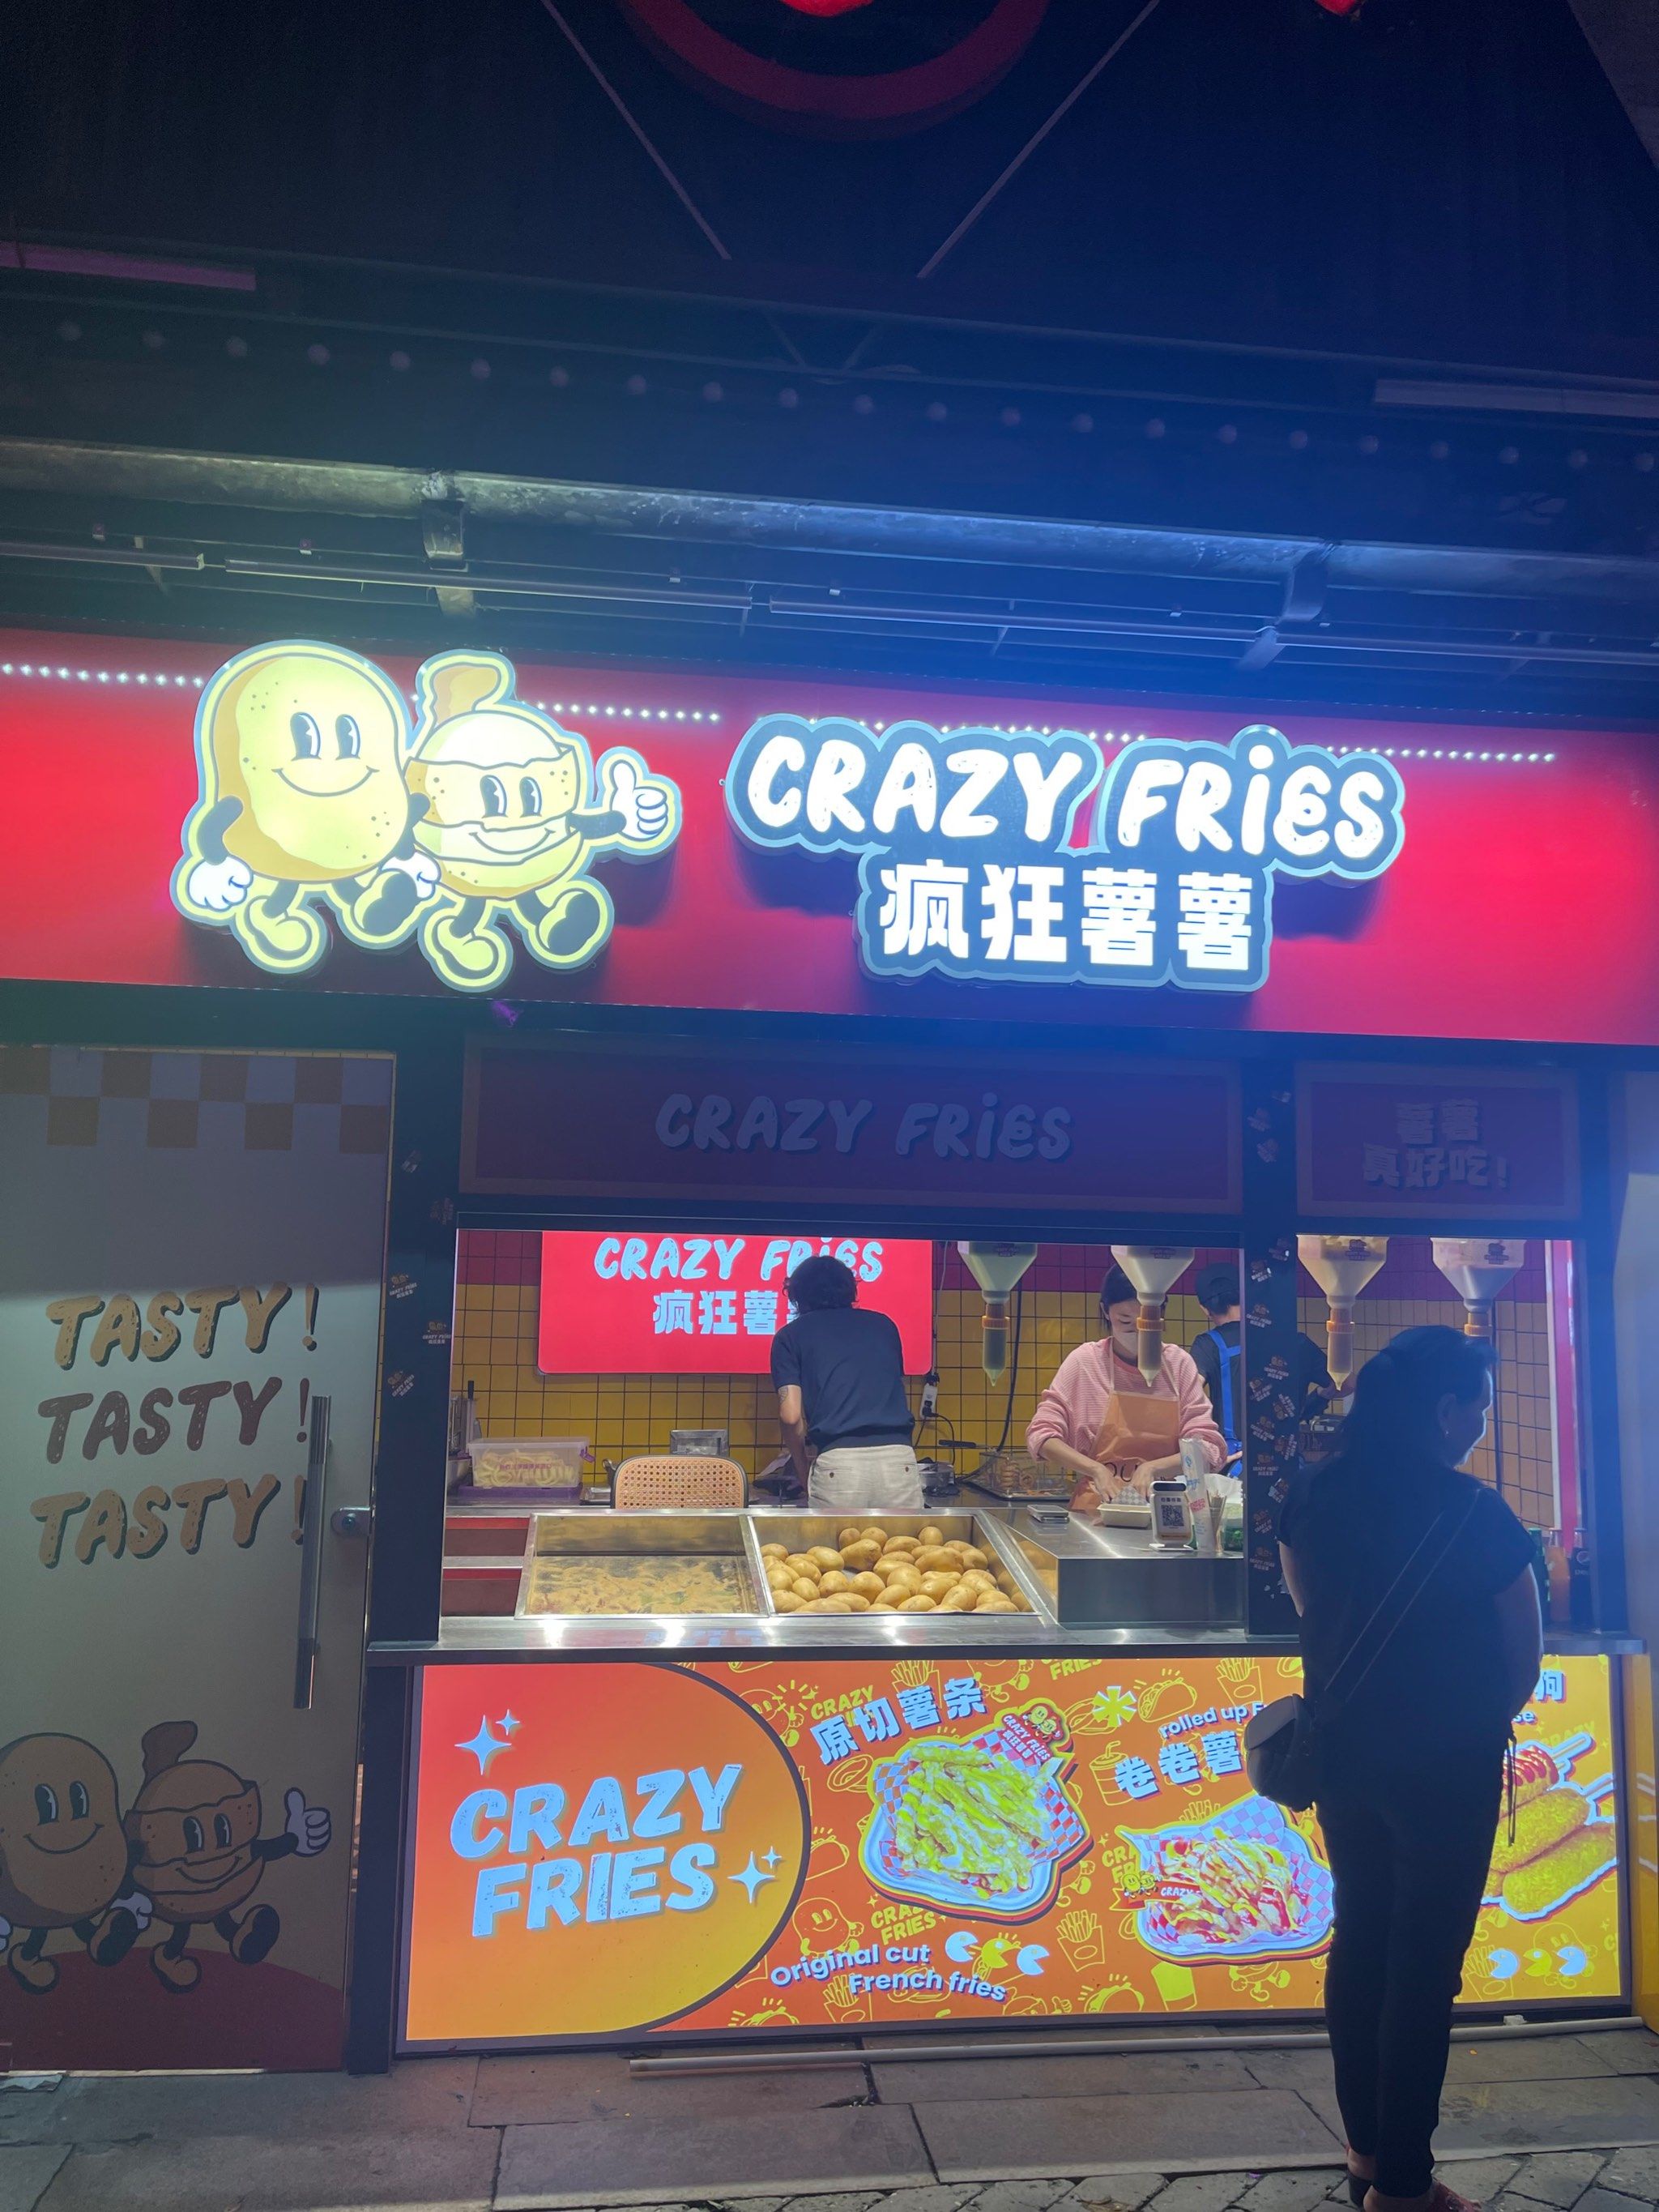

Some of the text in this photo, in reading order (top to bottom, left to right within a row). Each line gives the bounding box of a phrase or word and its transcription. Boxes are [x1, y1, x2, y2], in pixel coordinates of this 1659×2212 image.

[748, 734, 1081, 843] CRAZY
[880, 857, 1255, 972] 疯狂薯薯
[655, 1093, 874, 1154] CRAZY
[593, 1237, 745, 1280] CRAZY
[653, 1289, 800, 1336] 疯狂薯
[810, 1677, 987, 1766] 原切薯条
[811, 1685, 873, 1720] CRAZY
[1158, 1707, 1218, 1738] rolled
[1221, 1705, 1248, 1725] up
[450, 1764, 742, 1859] CRAZY
[471, 1843, 716, 1937] FRIES
[881, 1911, 936, 1945] FRIES
[770, 1945, 931, 1986] Original cut
[849, 1969, 1007, 2001] French fries
